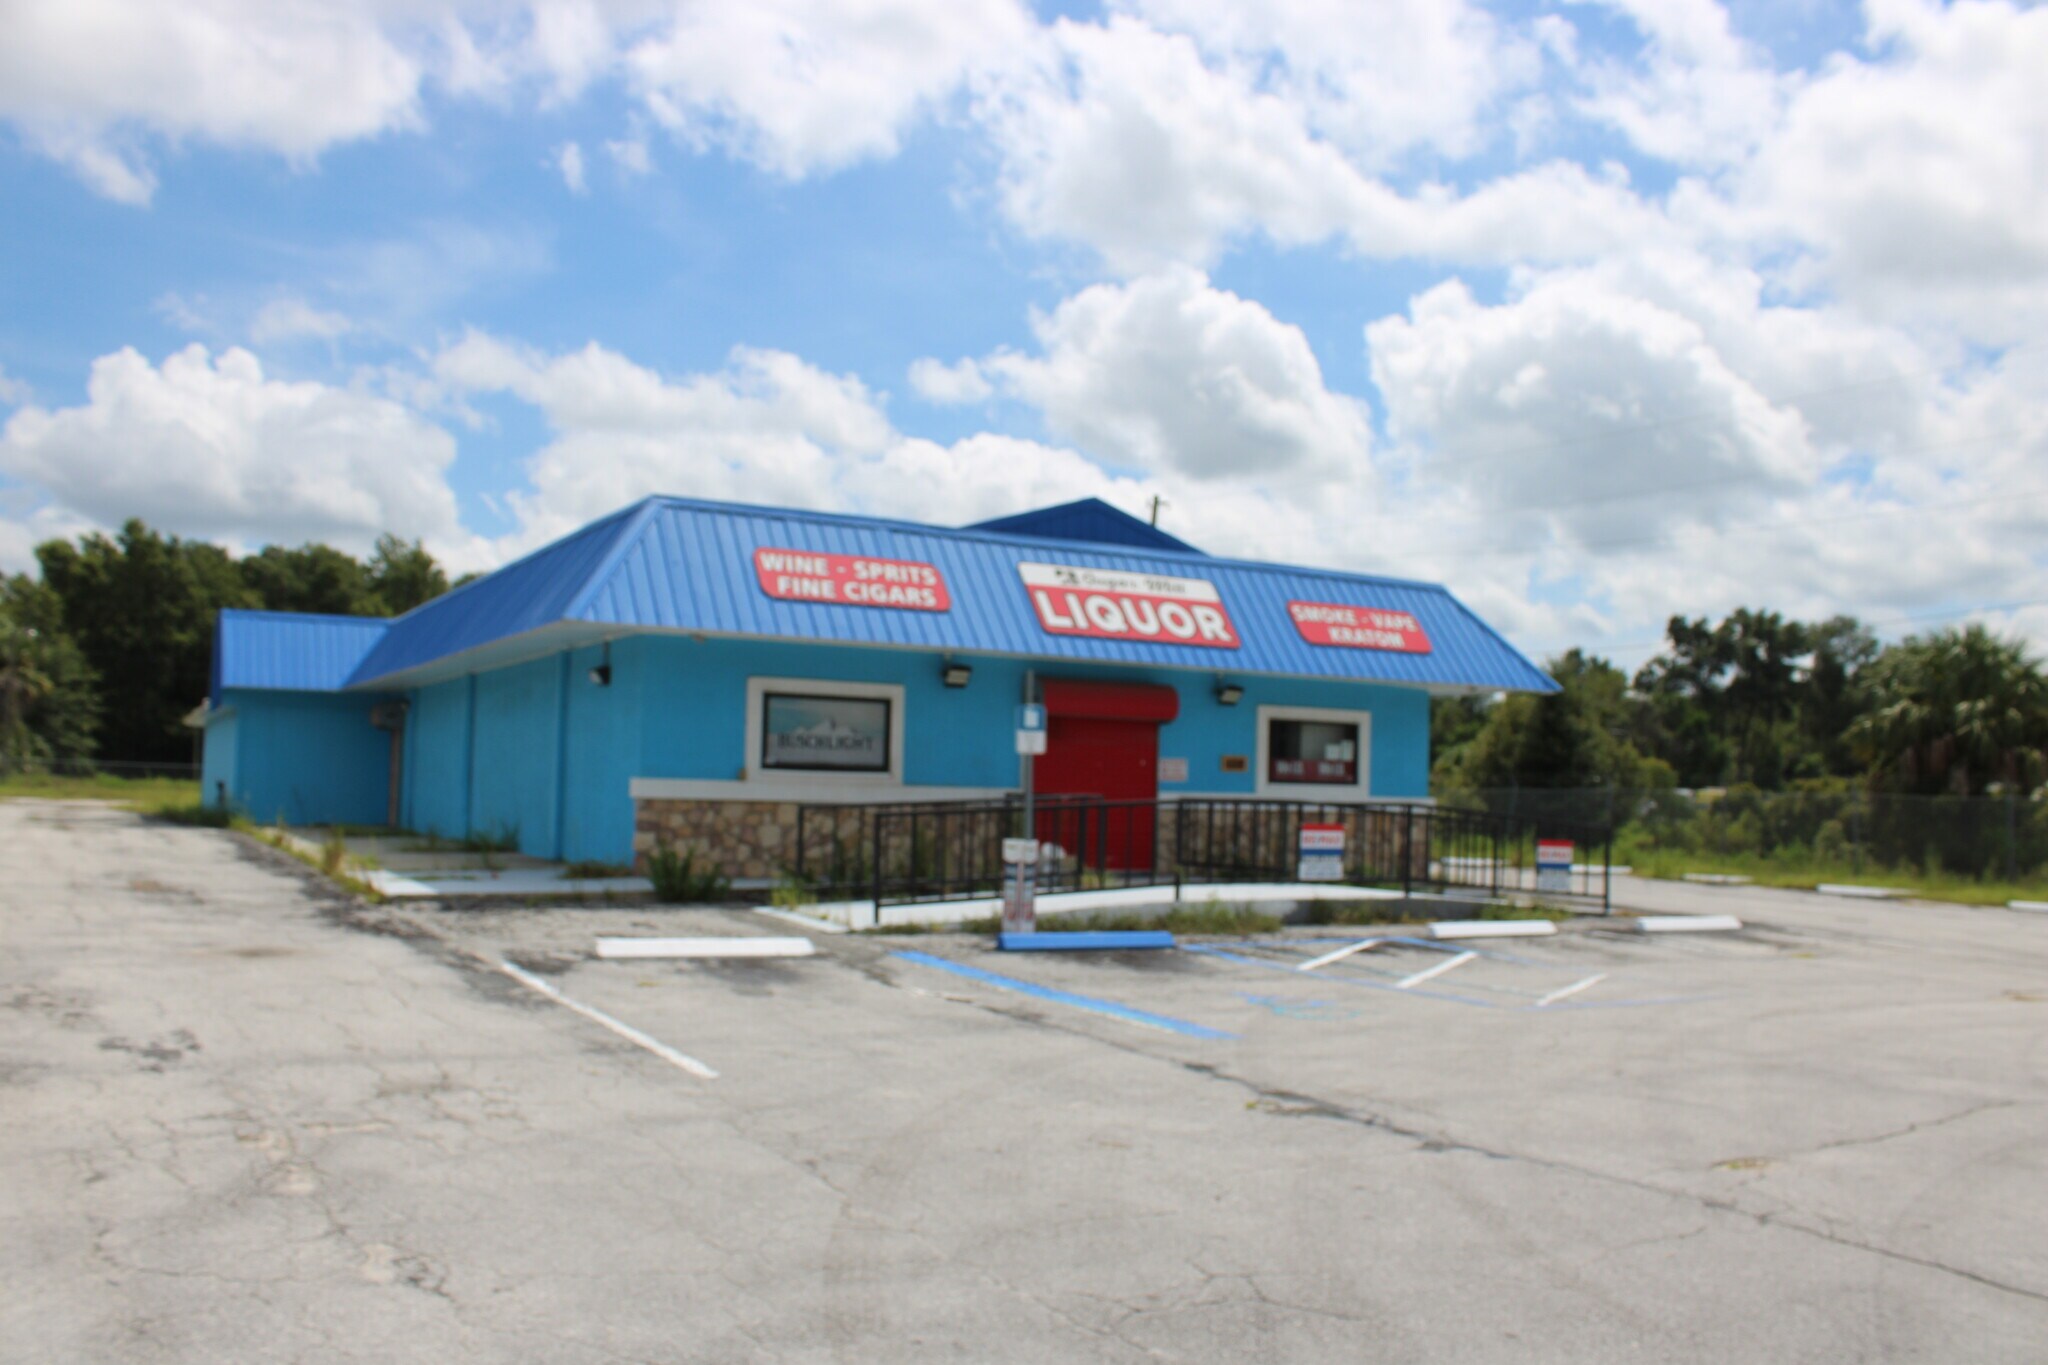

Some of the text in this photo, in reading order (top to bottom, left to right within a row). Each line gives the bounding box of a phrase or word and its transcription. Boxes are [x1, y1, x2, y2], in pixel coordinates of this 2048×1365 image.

[760, 552, 827, 575] WINE
[852, 560, 935, 584] SPRITS
[777, 576, 935, 606] FINE CIGARS
[1033, 590, 1231, 640] LIQUOR
[1290, 604, 1356, 624] SMOKE
